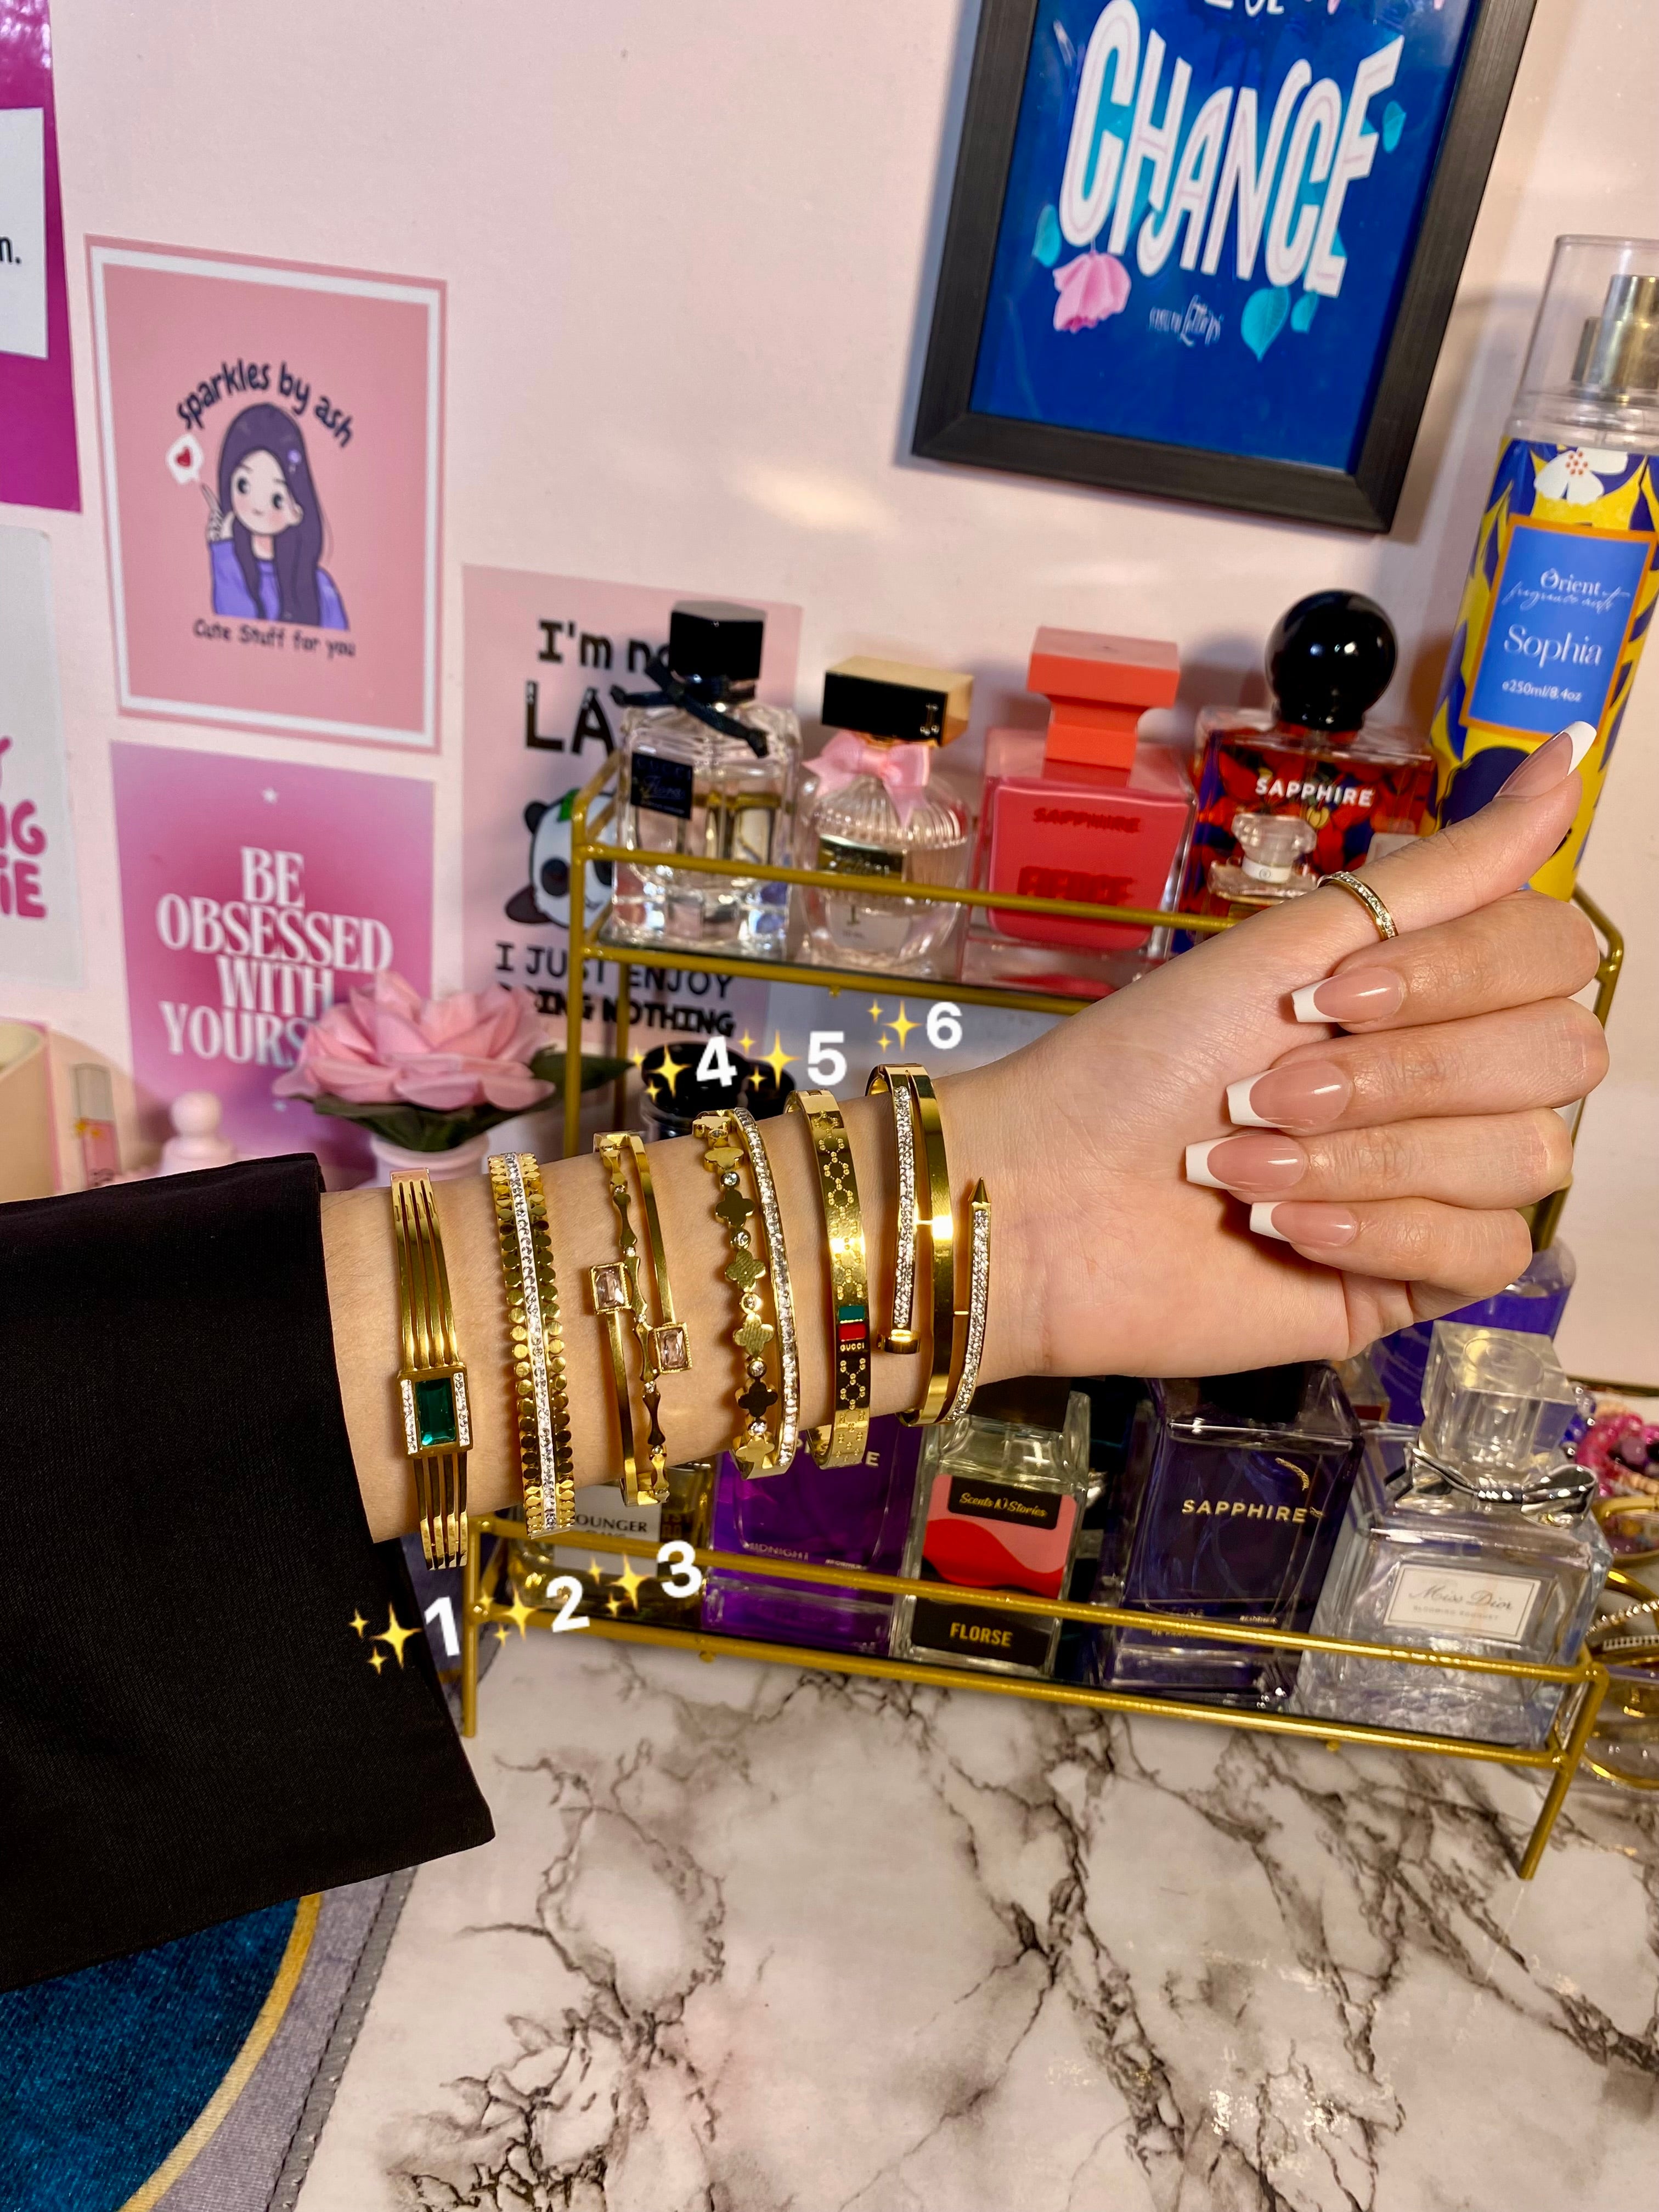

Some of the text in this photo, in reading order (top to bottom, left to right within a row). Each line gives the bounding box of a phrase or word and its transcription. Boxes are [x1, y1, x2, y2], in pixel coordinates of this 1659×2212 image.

[1060, 0, 1403, 298] CHANCE
[177, 358, 352, 448] sparkles by ash
[194, 618, 356, 661] Cute Stuff for you
[538, 619, 612, 670] I'm
[1504, 624, 1602, 669] Sophia
[526, 680, 616, 756] LA
[1255, 777, 1375, 807] SAPPHIRE
[241, 846, 306, 909] BE
[156, 893, 394, 973] OBSESSED
[495, 941, 514, 973] I
[216, 953, 334, 1019] WITH
[159, 1000, 308, 1069] YOURS
[840, 1342, 865, 1352] GUCCI
[576, 1513, 647, 1533] OUNGER
[959, 1492, 994, 1508] Scents
[1008, 1500, 1049, 1518] Stories
[1182, 1499, 1308, 1524] SAPPHIRE
[1408, 1584, 1513, 1611] Miss Dior
[950, 1622, 1013, 1647] FLORSE
